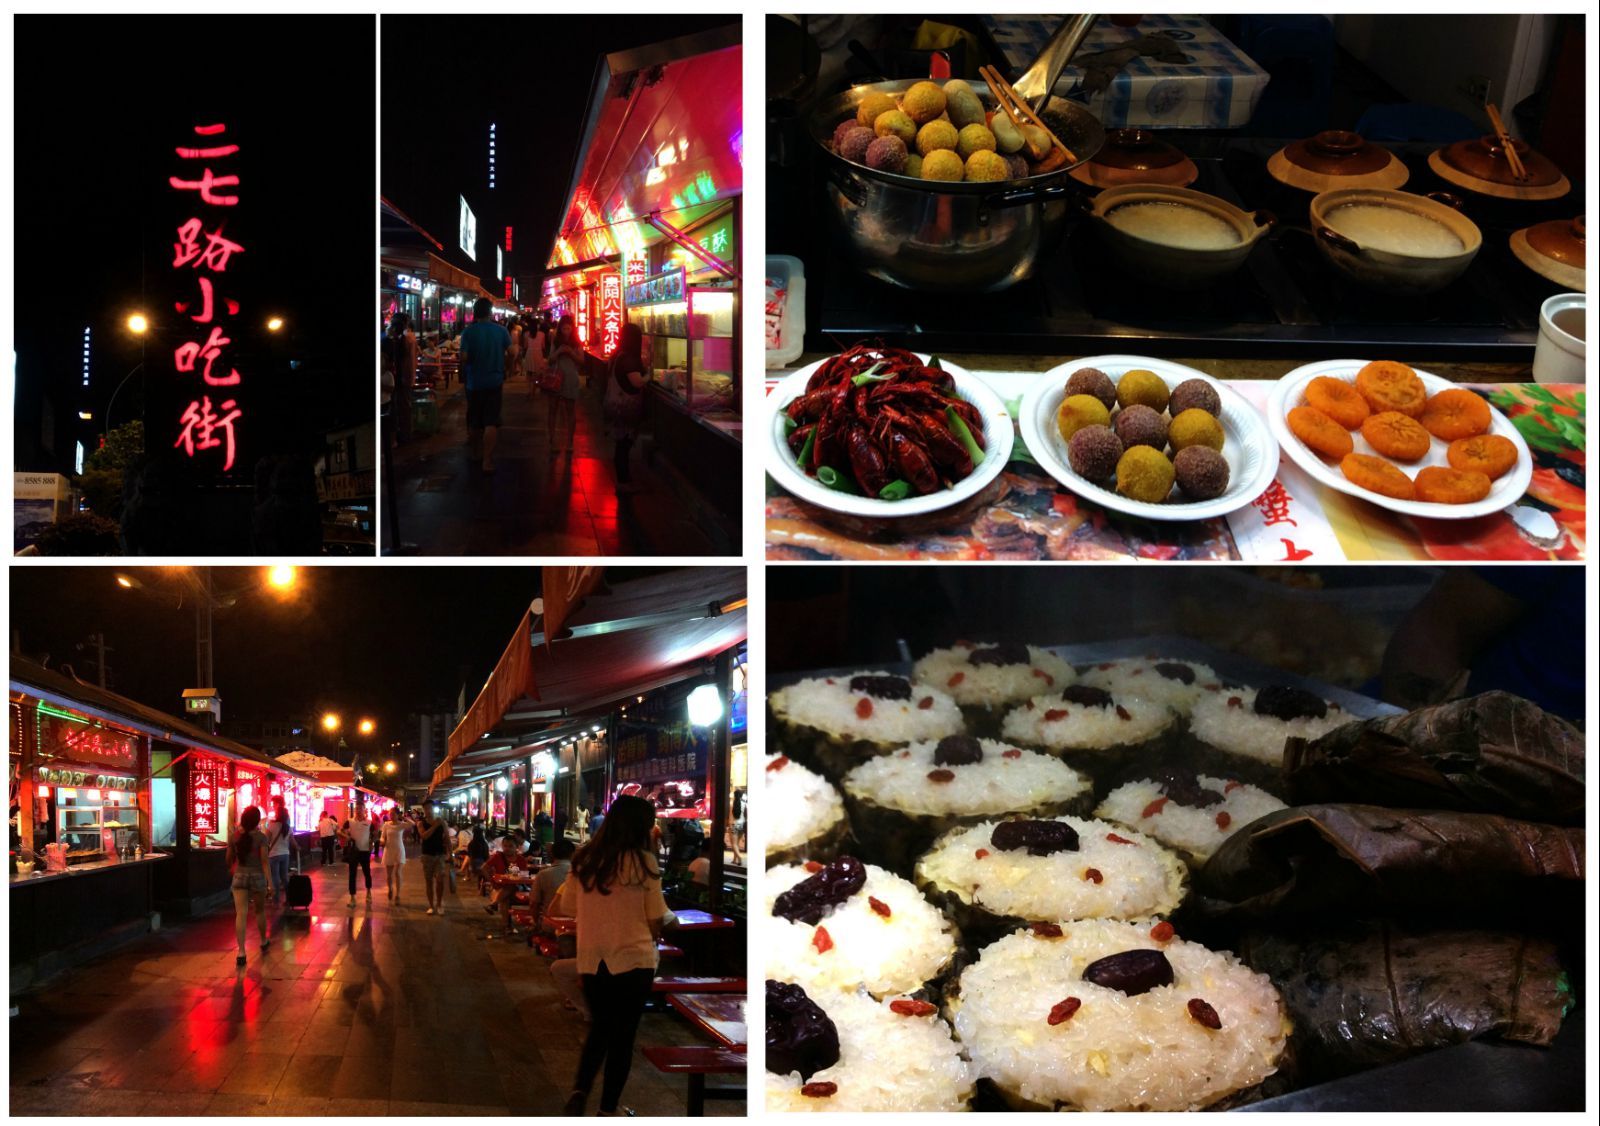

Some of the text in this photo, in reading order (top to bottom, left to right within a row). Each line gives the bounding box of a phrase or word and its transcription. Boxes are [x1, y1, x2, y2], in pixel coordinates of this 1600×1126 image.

[168, 123, 245, 472] 二七路小吃街
[194, 772, 213, 830] 火爆鱿鱼
